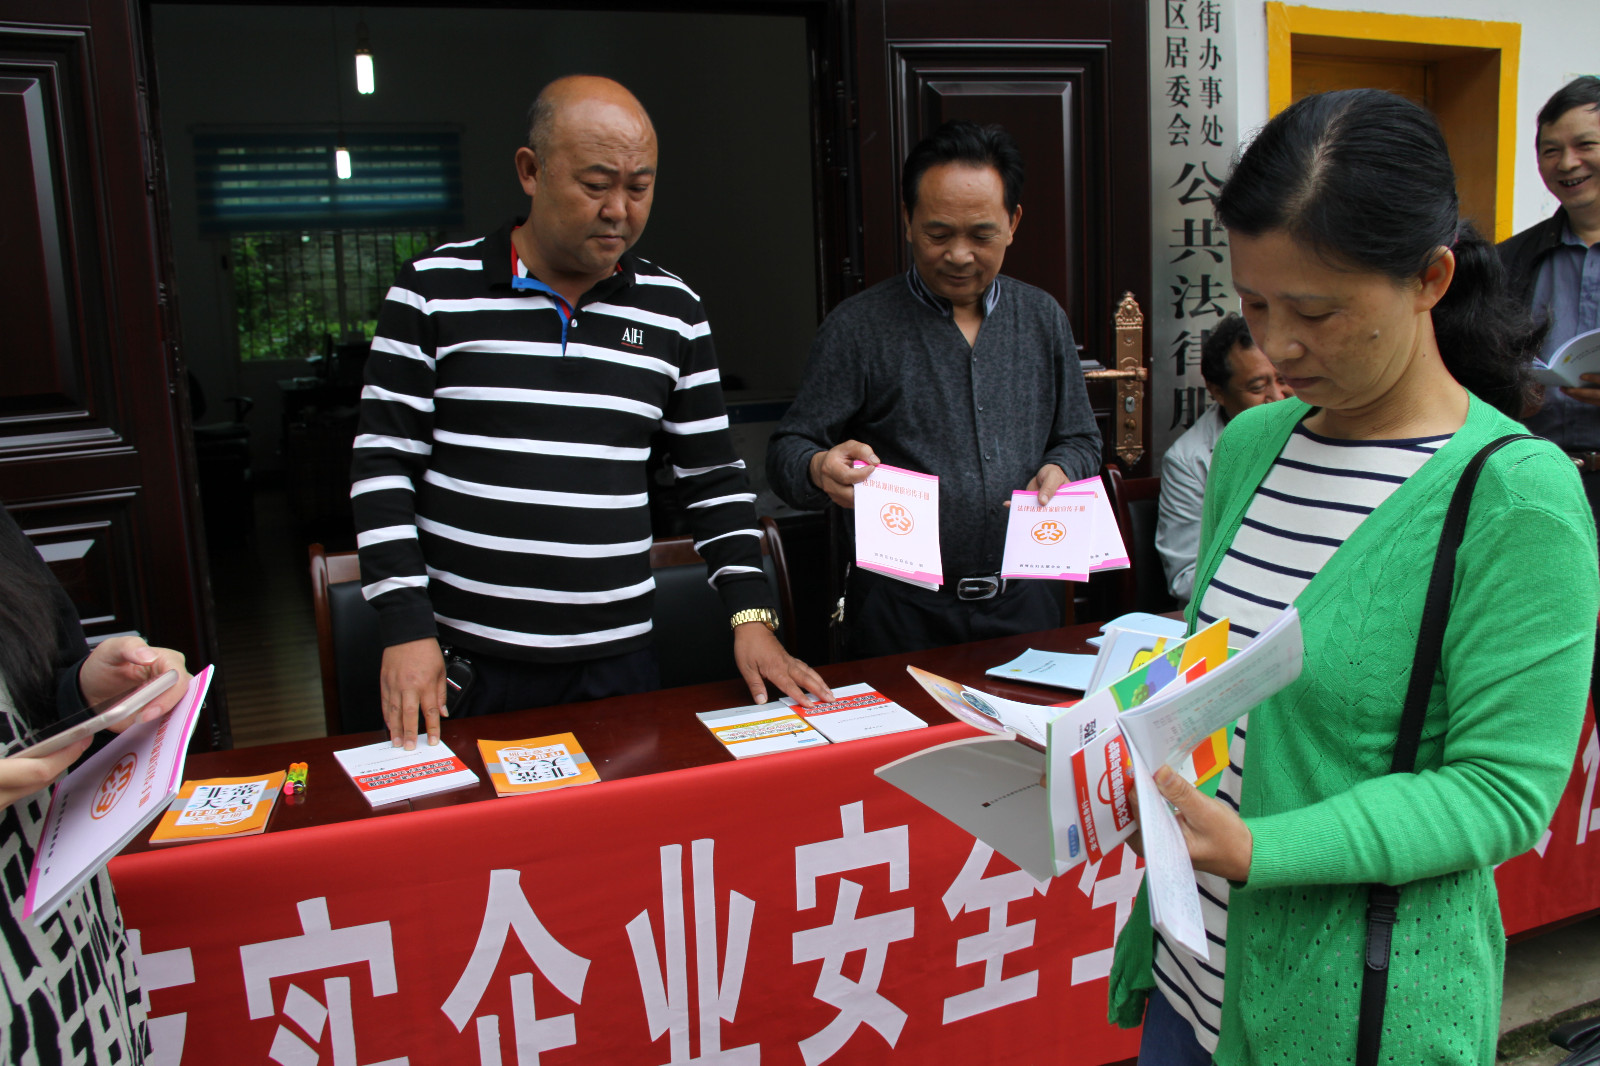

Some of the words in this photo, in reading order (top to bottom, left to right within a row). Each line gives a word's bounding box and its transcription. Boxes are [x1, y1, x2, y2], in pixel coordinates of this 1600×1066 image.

[1165, 0, 1191, 147] 区居委会
[1198, 0, 1223, 147] 街办事处
[1108, 740, 1131, 828] 灭火器的使用与维护
